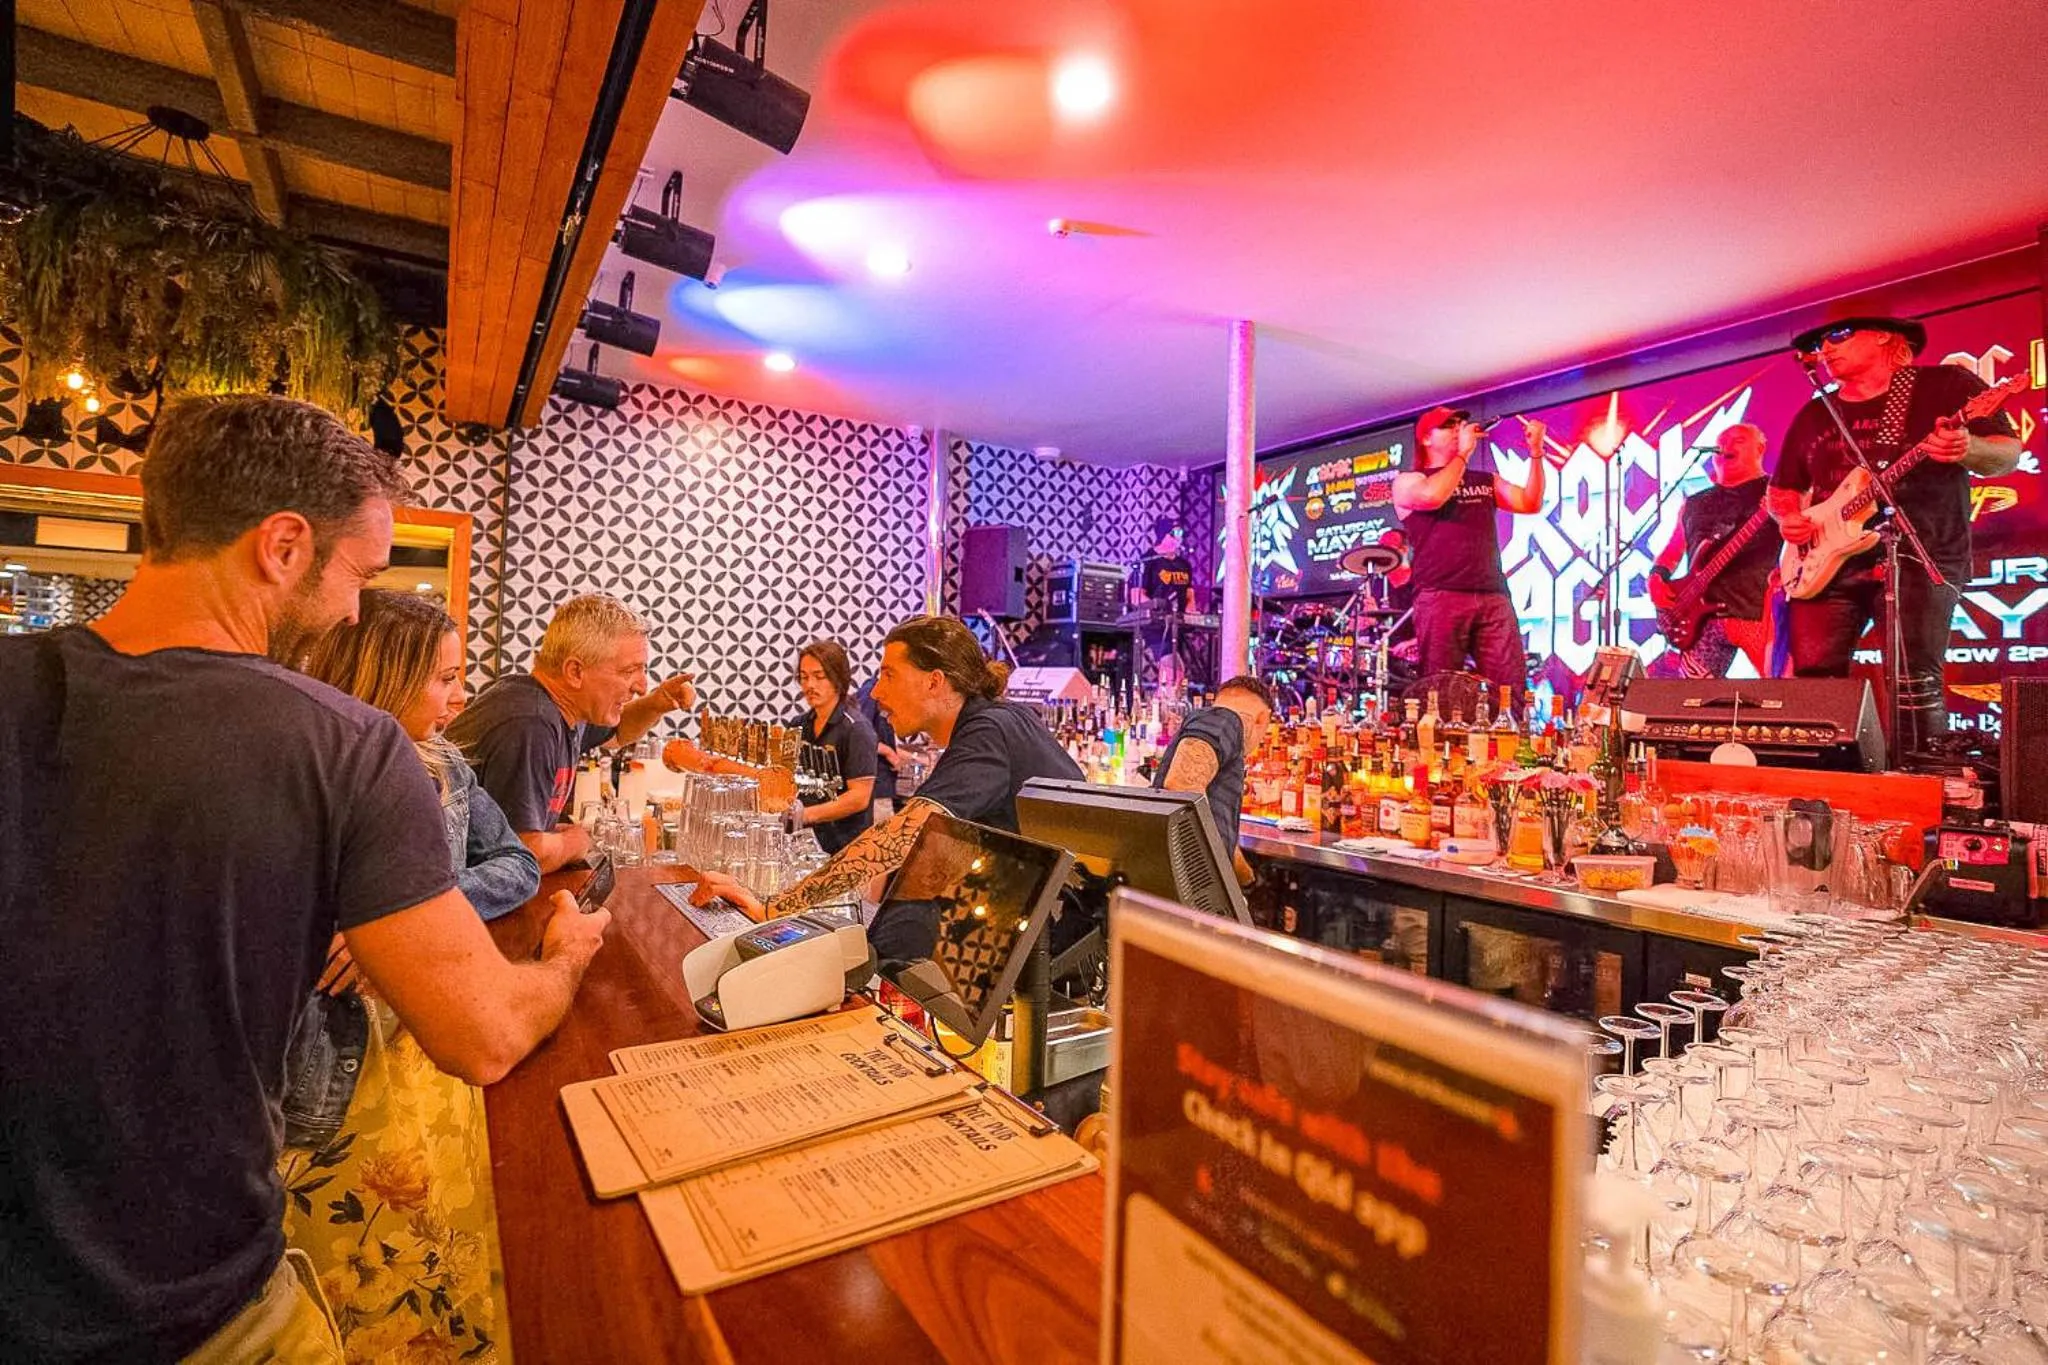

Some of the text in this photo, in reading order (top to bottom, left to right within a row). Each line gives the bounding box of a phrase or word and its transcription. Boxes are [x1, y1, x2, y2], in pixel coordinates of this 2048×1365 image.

[1490, 386, 1752, 580] ROCK
[1306, 532, 1361, 556] MAY
[840, 1053, 894, 1086] COCKTAILS
[864, 1047, 914, 1079] THE PUB
[982, 1121, 1019, 1141] PUB
